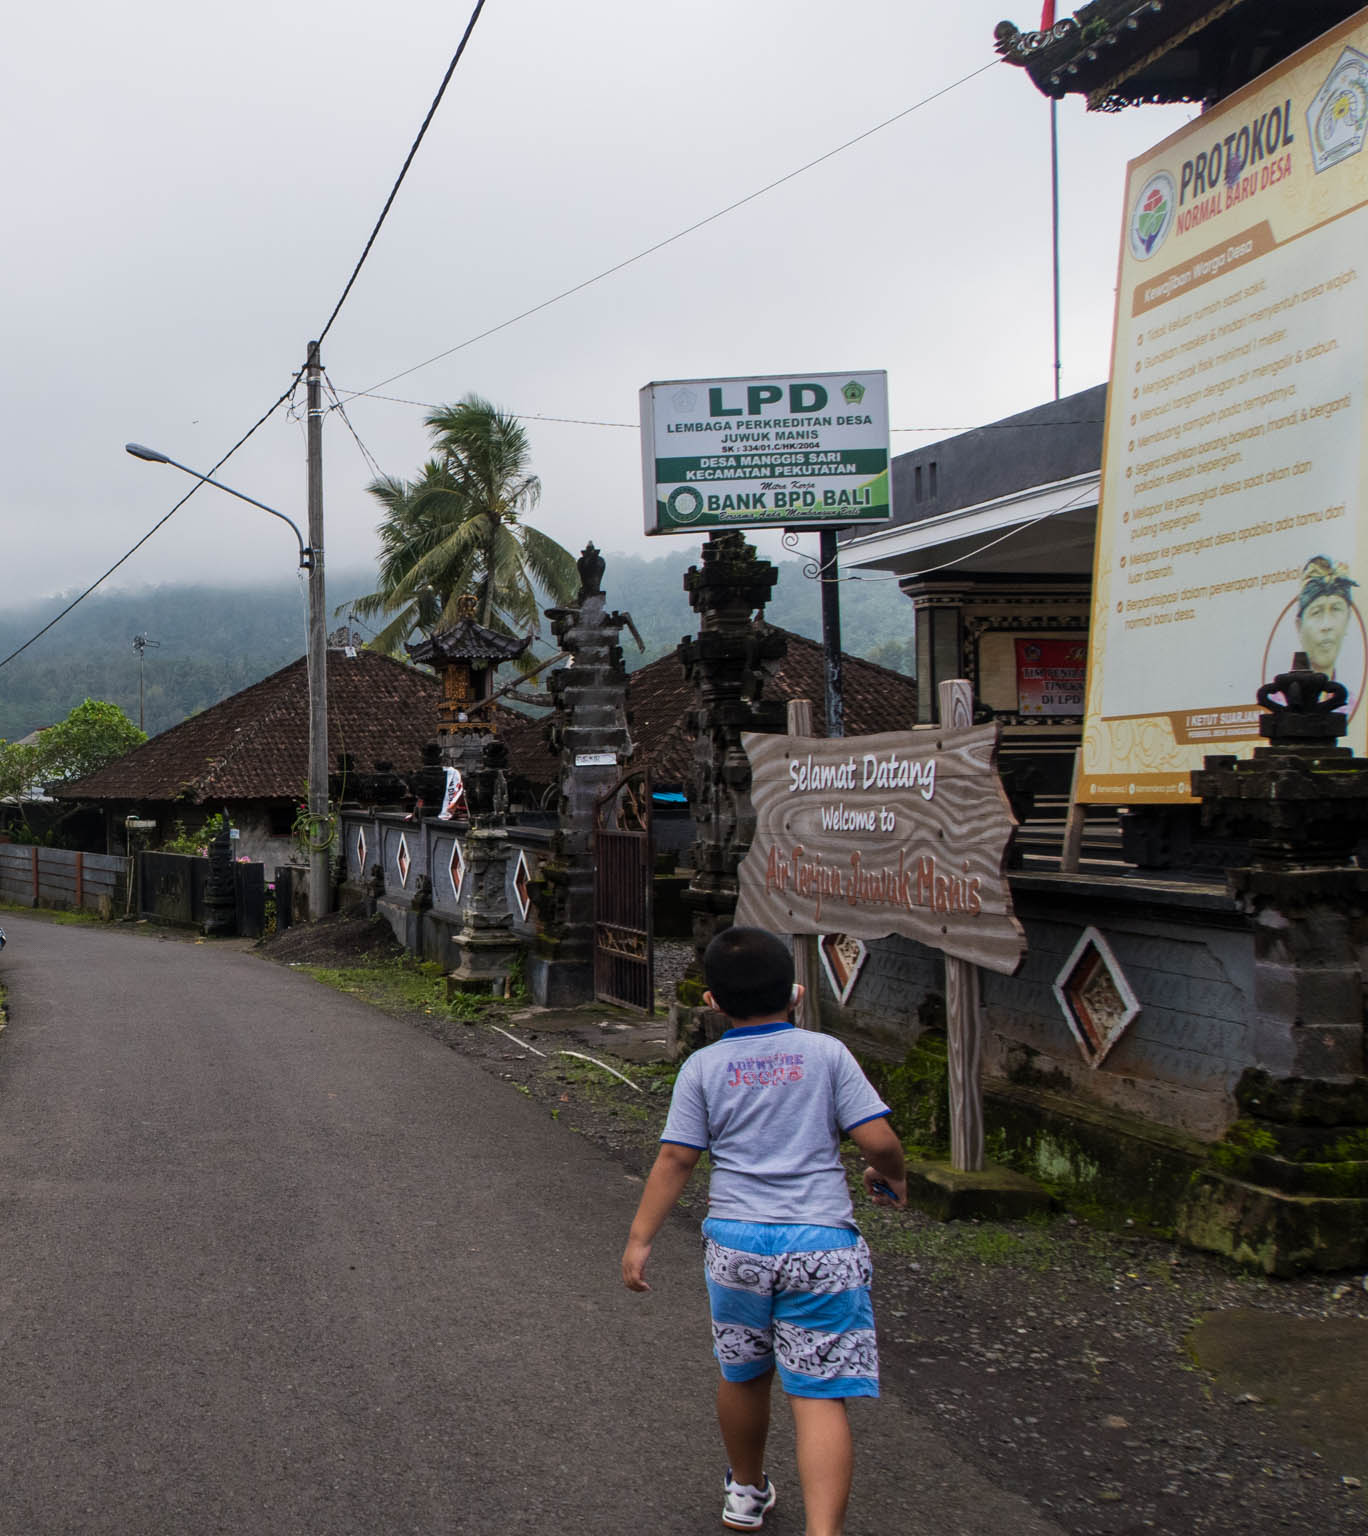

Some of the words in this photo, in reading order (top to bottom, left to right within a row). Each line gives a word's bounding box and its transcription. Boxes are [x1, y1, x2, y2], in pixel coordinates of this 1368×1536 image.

[1179, 98, 1295, 207] PROTOKOL
[1175, 191, 1223, 237] NORMAL
[1224, 171, 1259, 211] BARU
[1260, 152, 1292, 192] DESA
[708, 383, 829, 417] LPD
[667, 421, 733, 434] LEMBAGA
[736, 417, 833, 431] PERKREDITAN
[836, 415, 873, 426] DESA
[721, 432, 771, 444] JUWUK
[774, 430, 819, 441] MANIS
[686, 468, 771, 481] KECAMATAN
[774, 464, 857, 477] PEKUTATAN
[700, 457, 736, 468] DESA
[740, 454, 805, 466] MANGGIS
[808, 452, 841, 463] SARI
[707, 493, 766, 512] BANK
[774, 490, 817, 509] BPD
[822, 488, 871, 507] BALI
[1041, 695, 1053, 704] DI
[1058, 695, 1081, 705] LPD
[789, 754, 857, 792] Selamat
[863, 753, 936, 801] Datang
[821, 803, 876, 832] Welcome
[879, 806, 896, 832] to
[766, 843, 791, 896] Air
[917, 855, 982, 918] Manis
